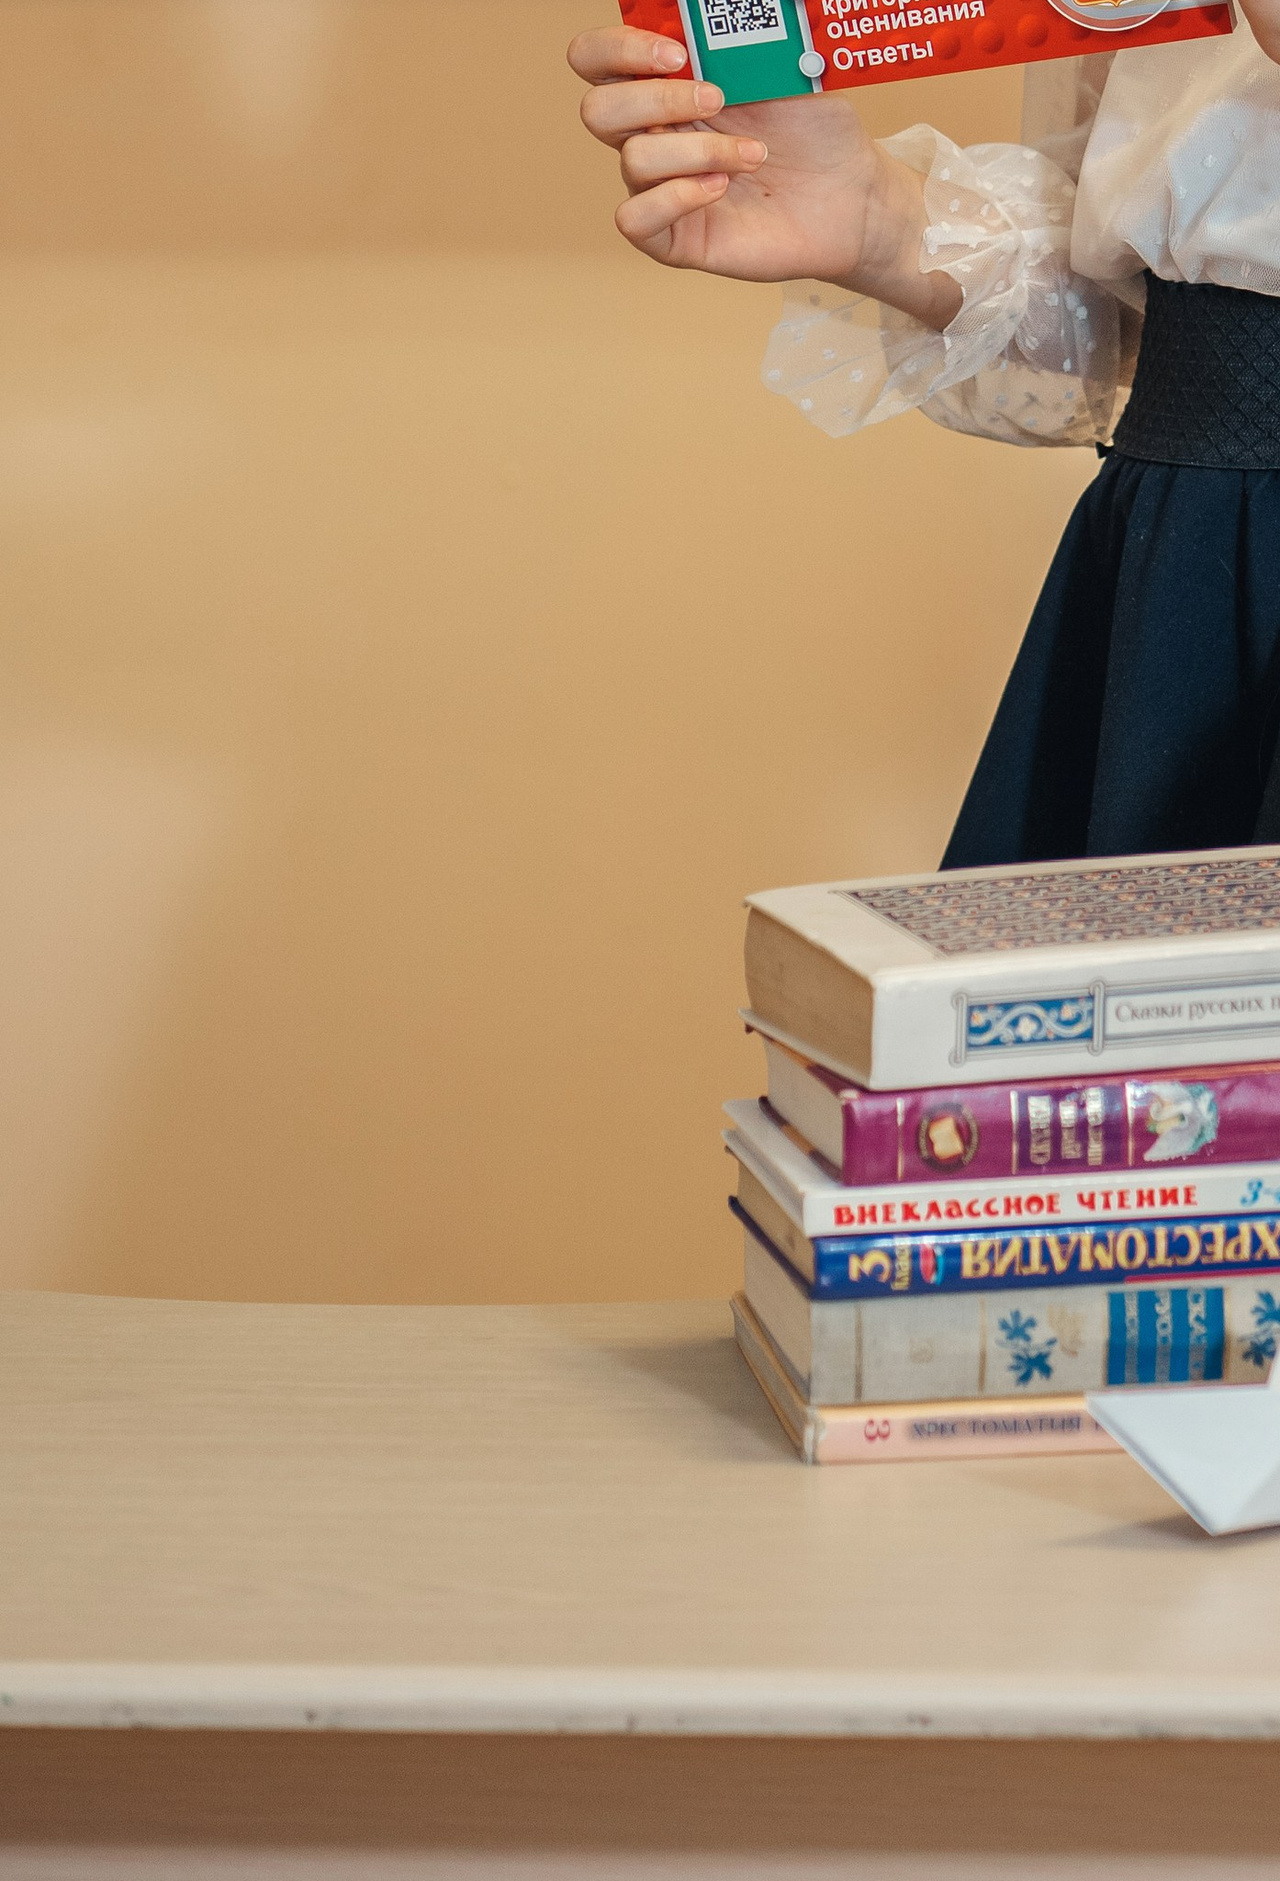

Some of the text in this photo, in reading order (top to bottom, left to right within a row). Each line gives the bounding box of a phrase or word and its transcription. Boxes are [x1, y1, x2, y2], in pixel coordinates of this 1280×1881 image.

[826, 0, 986, 40] оценивания
[832, 39, 934, 70] Ответы
[1114, 999, 1182, 1023] Сказки
[1187, 995, 1265, 1021] русских
[1077, 1184, 1198, 1212] ЧТЕНИЕ
